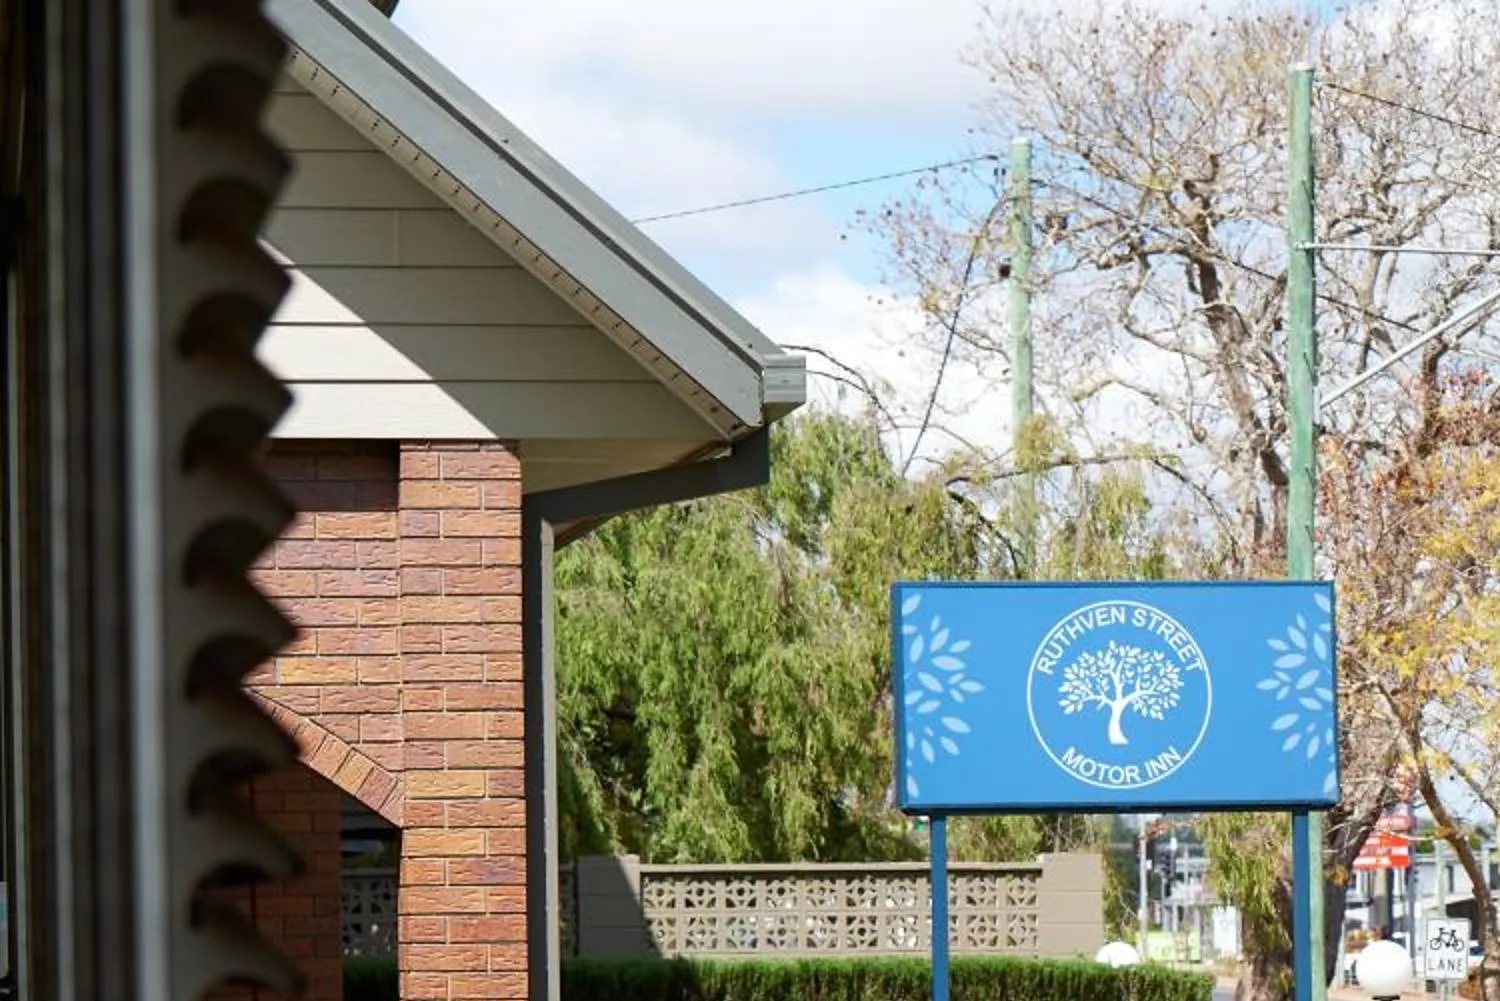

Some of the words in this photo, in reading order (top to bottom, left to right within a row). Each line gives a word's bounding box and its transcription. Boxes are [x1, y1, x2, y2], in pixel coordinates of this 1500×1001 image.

[1037, 606, 1126, 675] RUTHVEN
[1131, 607, 1203, 672] STREET
[1061, 745, 1141, 784] MOTOR
[1144, 745, 1182, 778] INN
[1427, 957, 1463, 973] LANE
